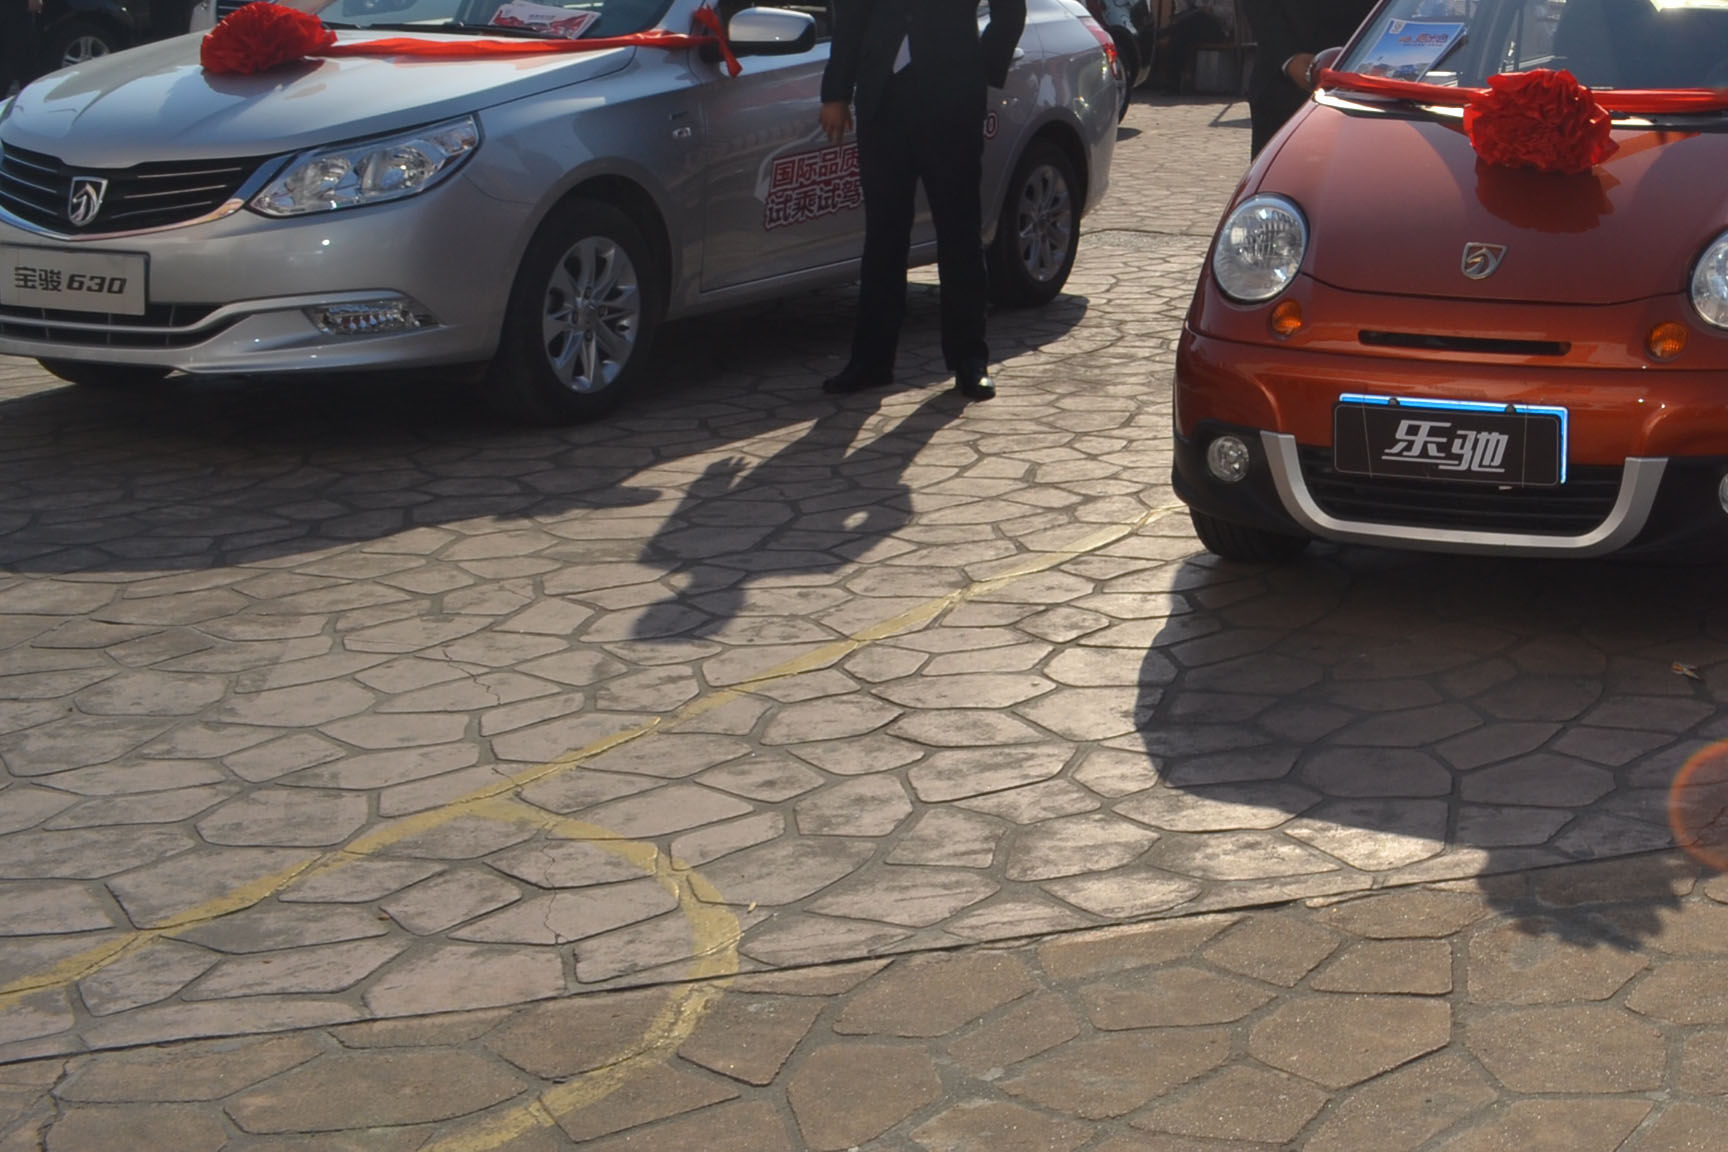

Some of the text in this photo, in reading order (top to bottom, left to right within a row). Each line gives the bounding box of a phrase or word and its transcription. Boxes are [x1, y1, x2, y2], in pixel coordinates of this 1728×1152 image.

[772, 146, 860, 190] 国际品质
[766, 180, 862, 227] 试乘试驾
[1382, 419, 1509, 472] 乐驰
